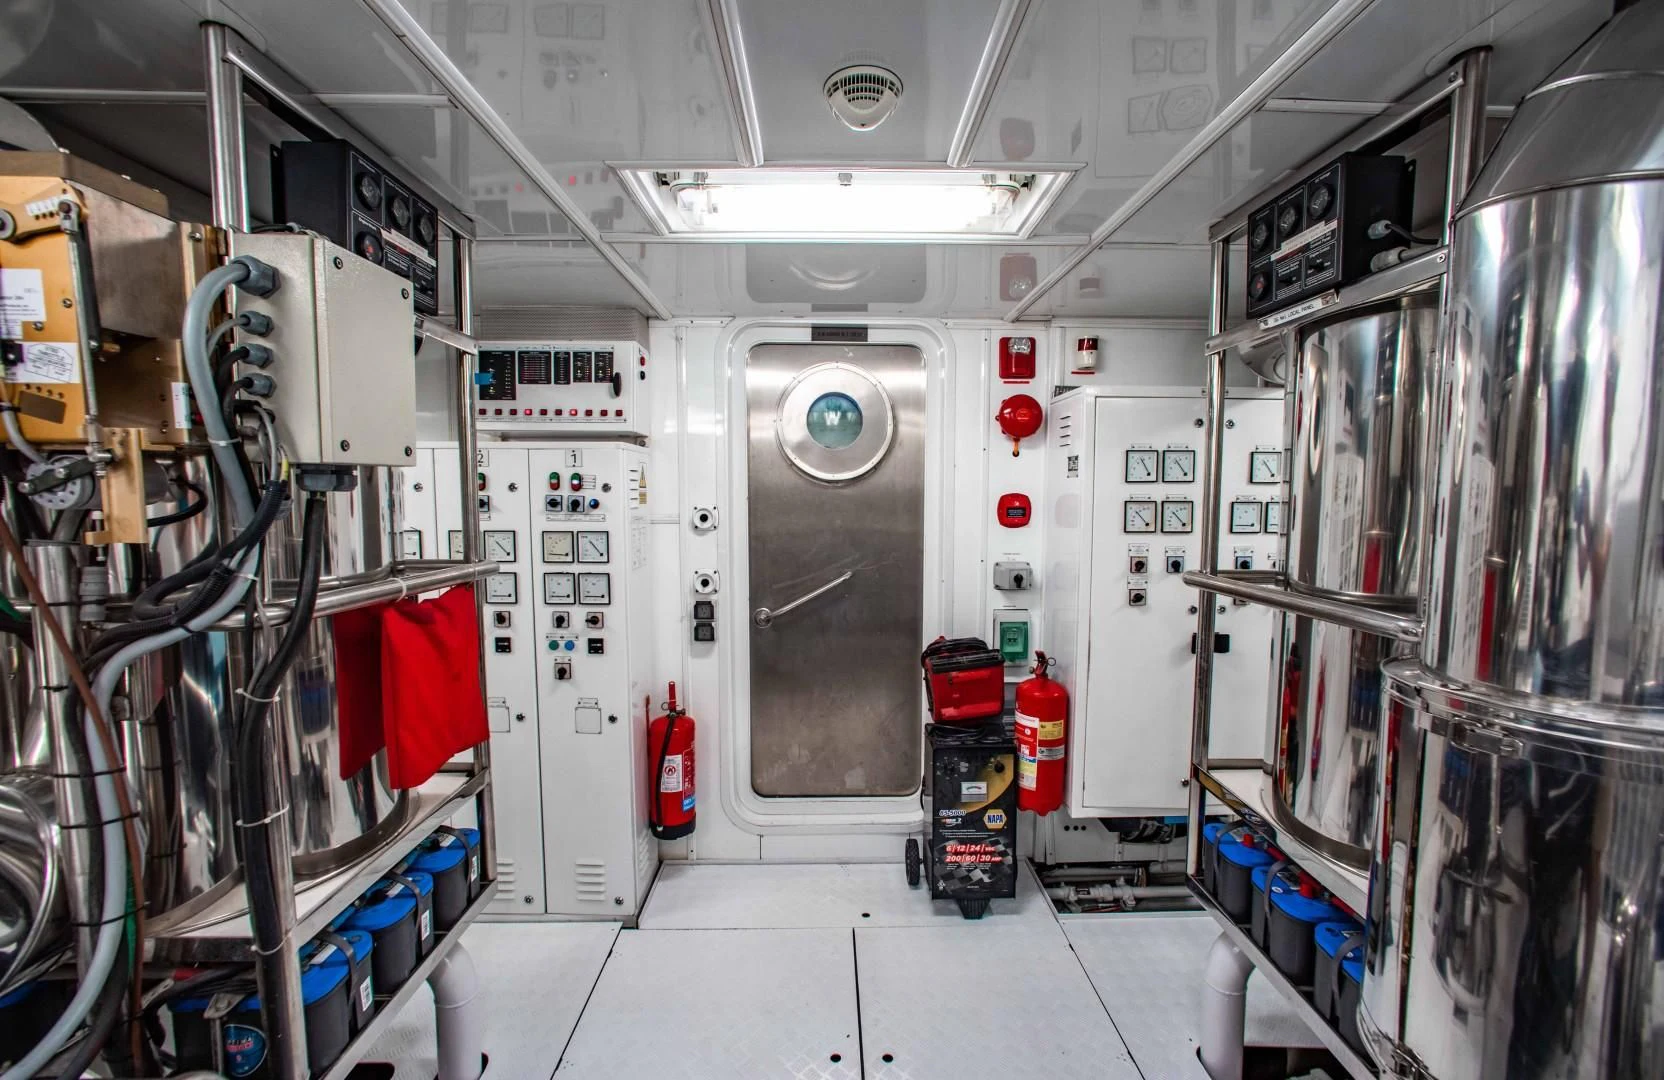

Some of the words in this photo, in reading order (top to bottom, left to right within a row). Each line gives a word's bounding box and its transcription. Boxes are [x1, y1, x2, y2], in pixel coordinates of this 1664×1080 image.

[1287, 309, 1301, 318] LOCAL
[1301, 303, 1315, 312] PANEL
[477, 453, 484, 464] 2
[570, 453, 577, 463] 1
[987, 814, 1004, 824] NAPA
